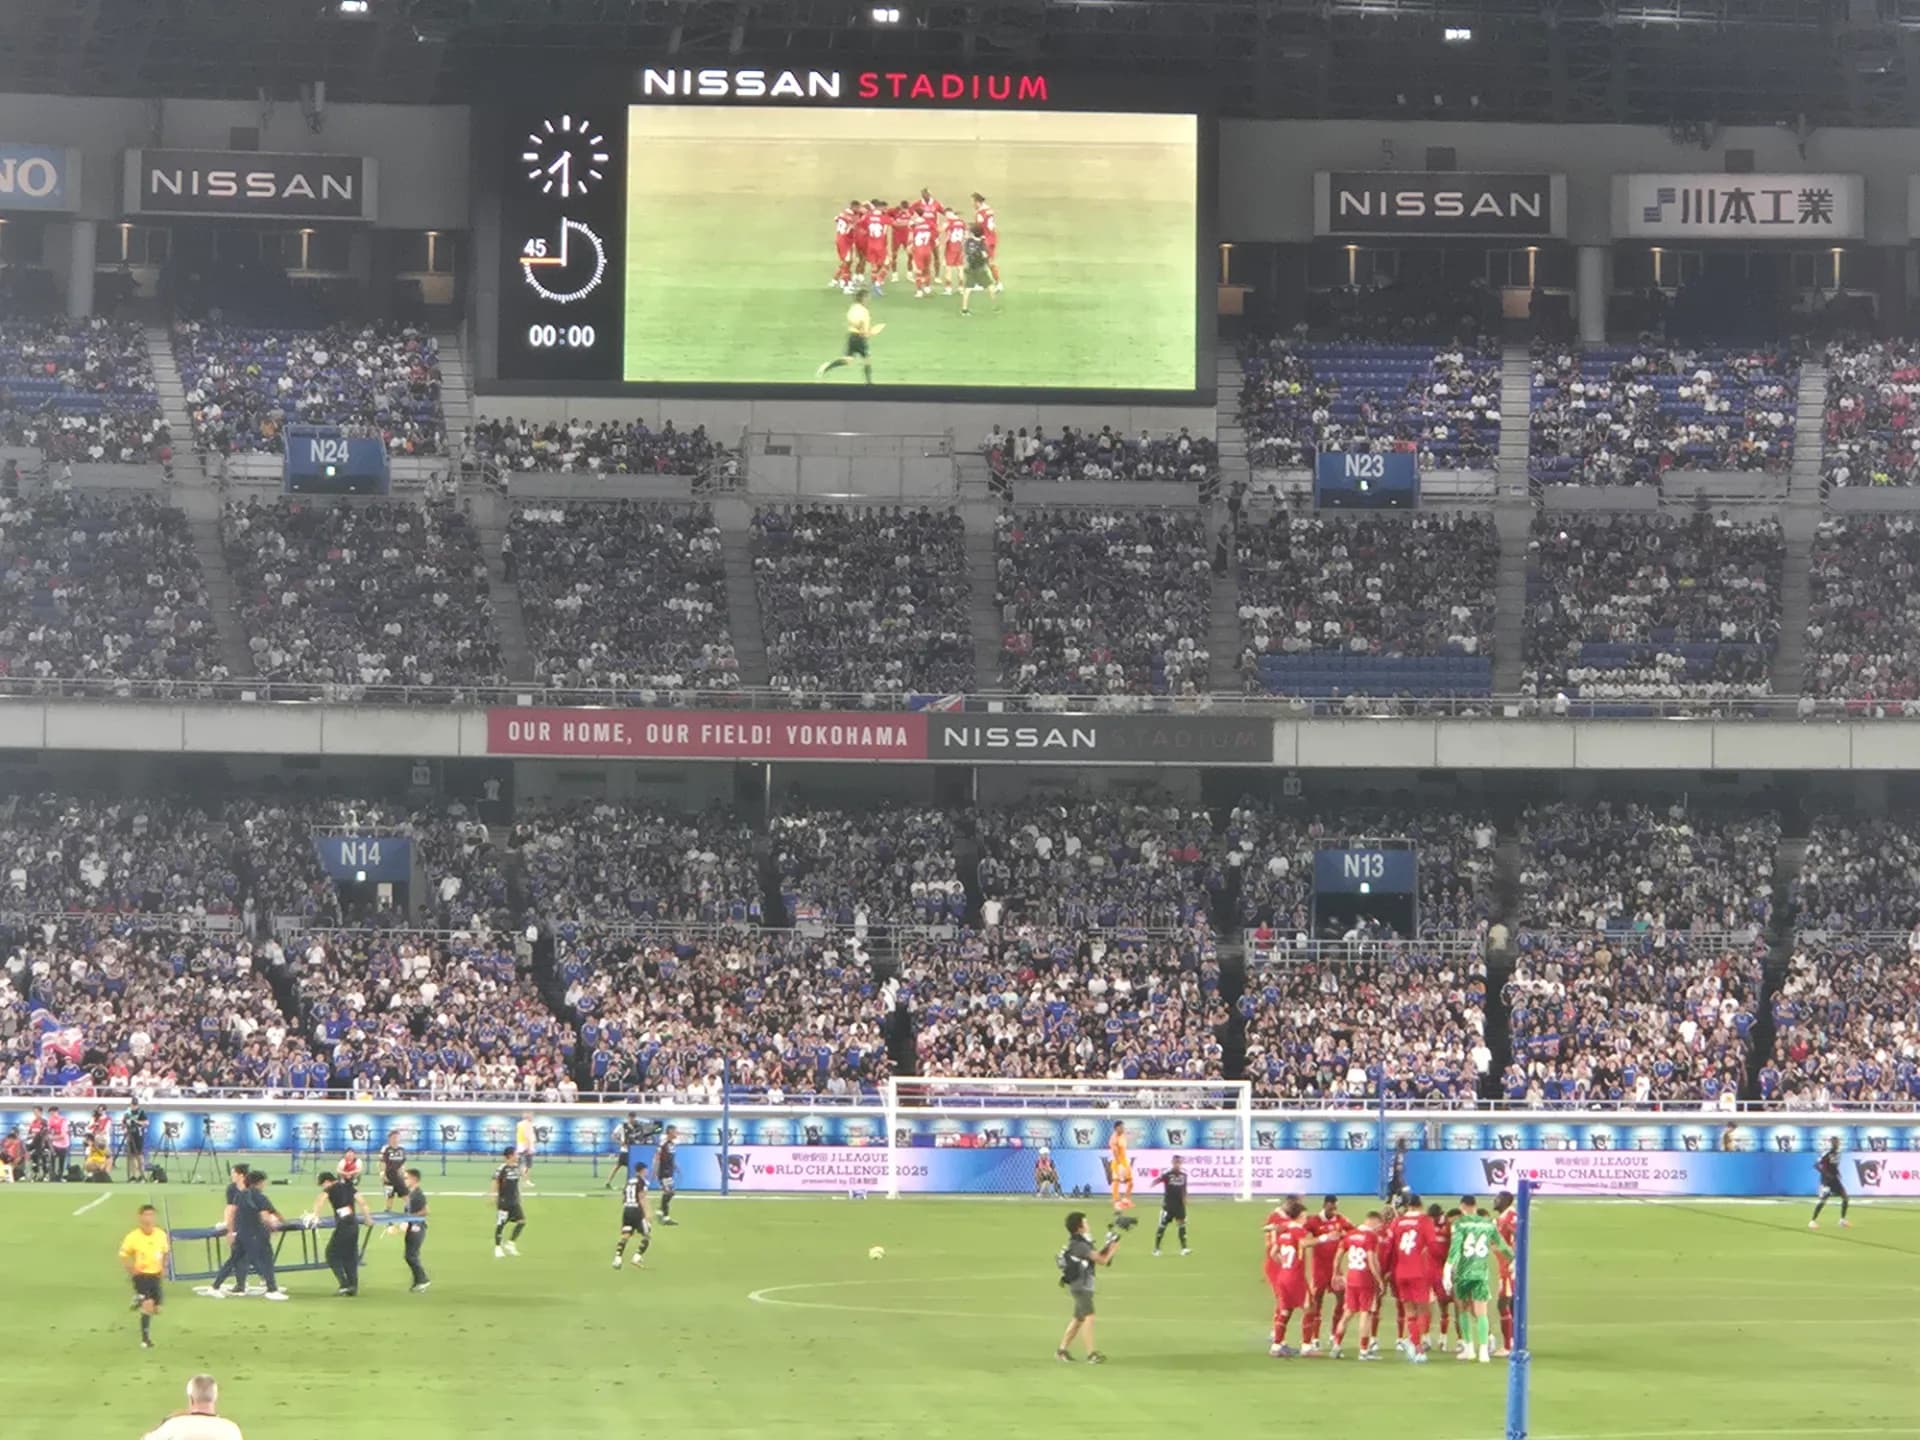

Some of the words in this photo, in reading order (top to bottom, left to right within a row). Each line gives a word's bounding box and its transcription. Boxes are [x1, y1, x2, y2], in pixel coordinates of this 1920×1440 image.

[643, 69, 840, 97] NISSAN
[858, 72, 1048, 100] STADIUM
[151, 169, 352, 199] NISSAN
[1340, 190, 1541, 218] NISSAN
[1681, 187, 1834, 225] 川本工業
[524, 238, 547, 257] 45
[529, 325, 595, 347] 00:00
[310, 439, 349, 462] N24
[1345, 454, 1384, 477] N23
[508, 720, 551, 741] OUR
[562, 722, 633, 745] HOME,
[646, 723, 689, 743] OUR
[701, 724, 772, 745] FIELD!
[786, 726, 908, 746] YOKOHAMA
[944, 727, 1096, 748] NISSAN
[341, 841, 381, 865] N14
[1344, 853, 1384, 878] N13
[805, 1165, 890, 1176] CHALLENGE
[1277, 1168, 1313, 1179] 2025
[1568, 1169, 1650, 1179] CHALLENGE
[1653, 1169, 1688, 1180] 2025
[1399, 1230, 1418, 1255] 4
